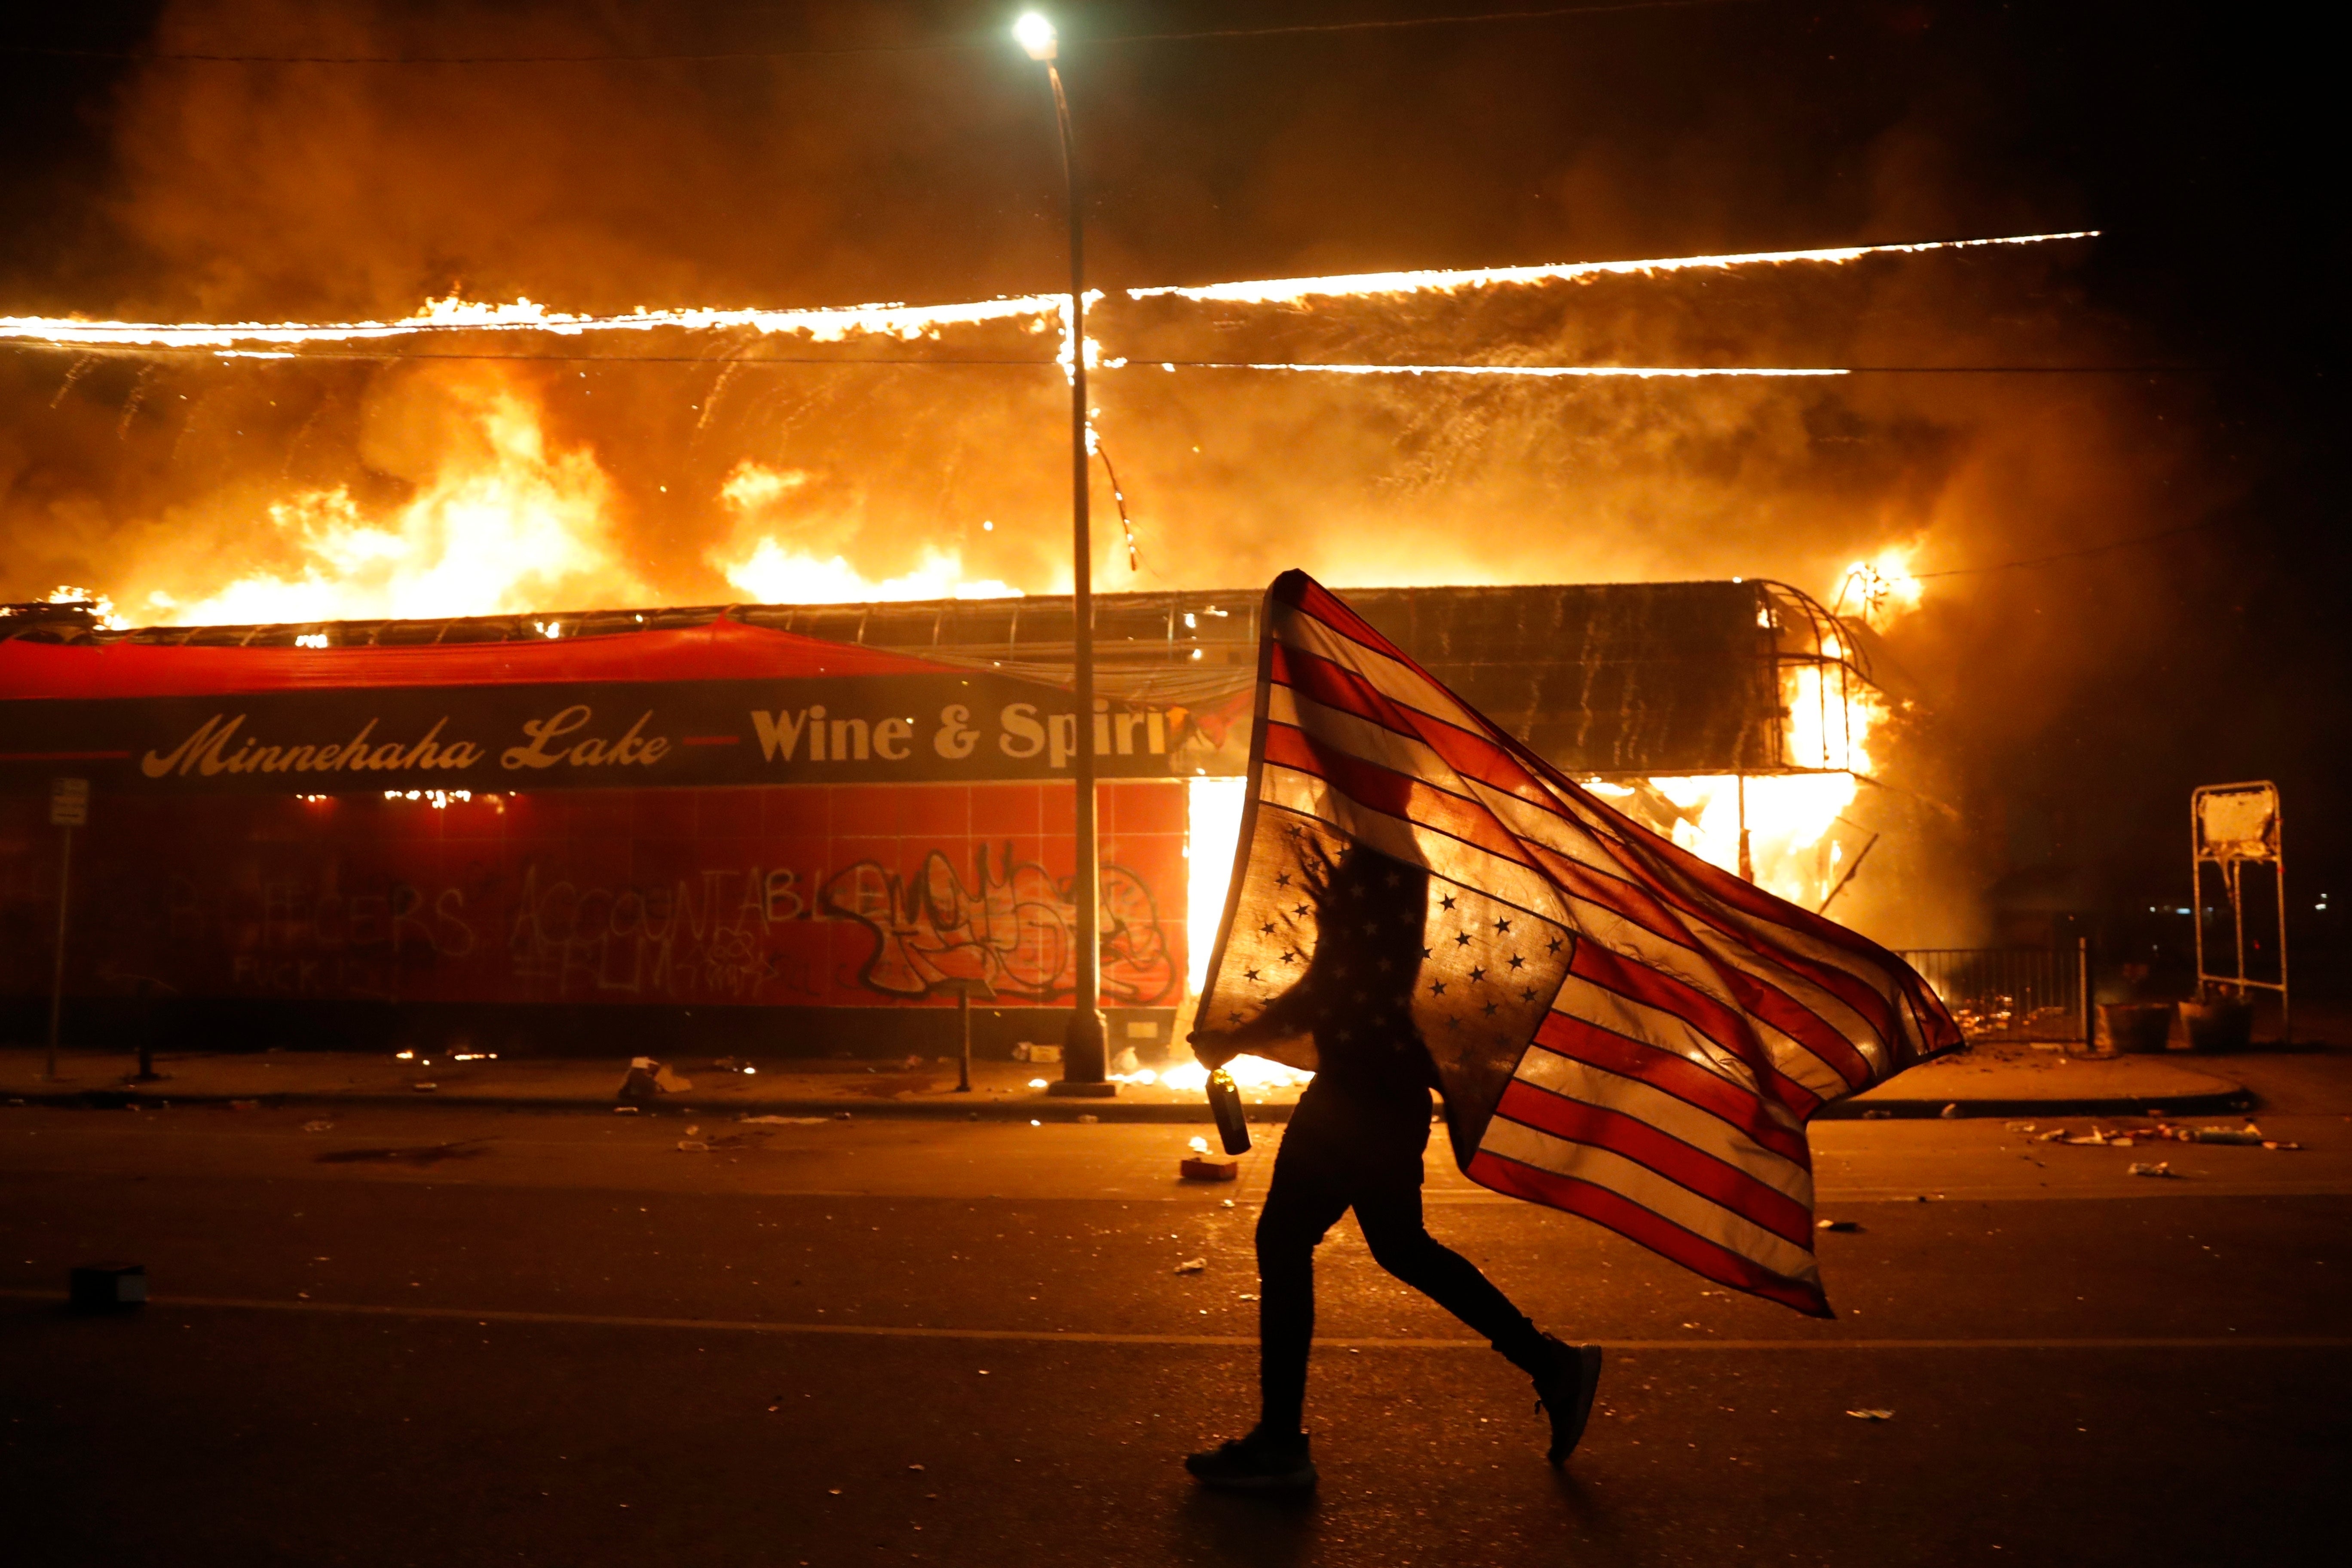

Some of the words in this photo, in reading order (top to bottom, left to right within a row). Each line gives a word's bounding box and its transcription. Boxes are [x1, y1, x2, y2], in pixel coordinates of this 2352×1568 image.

[140, 713, 486, 777] Minnehaha
[500, 705, 671, 770] Lake
[751, 705, 913, 762] Wine
[933, 704, 980, 760] &
